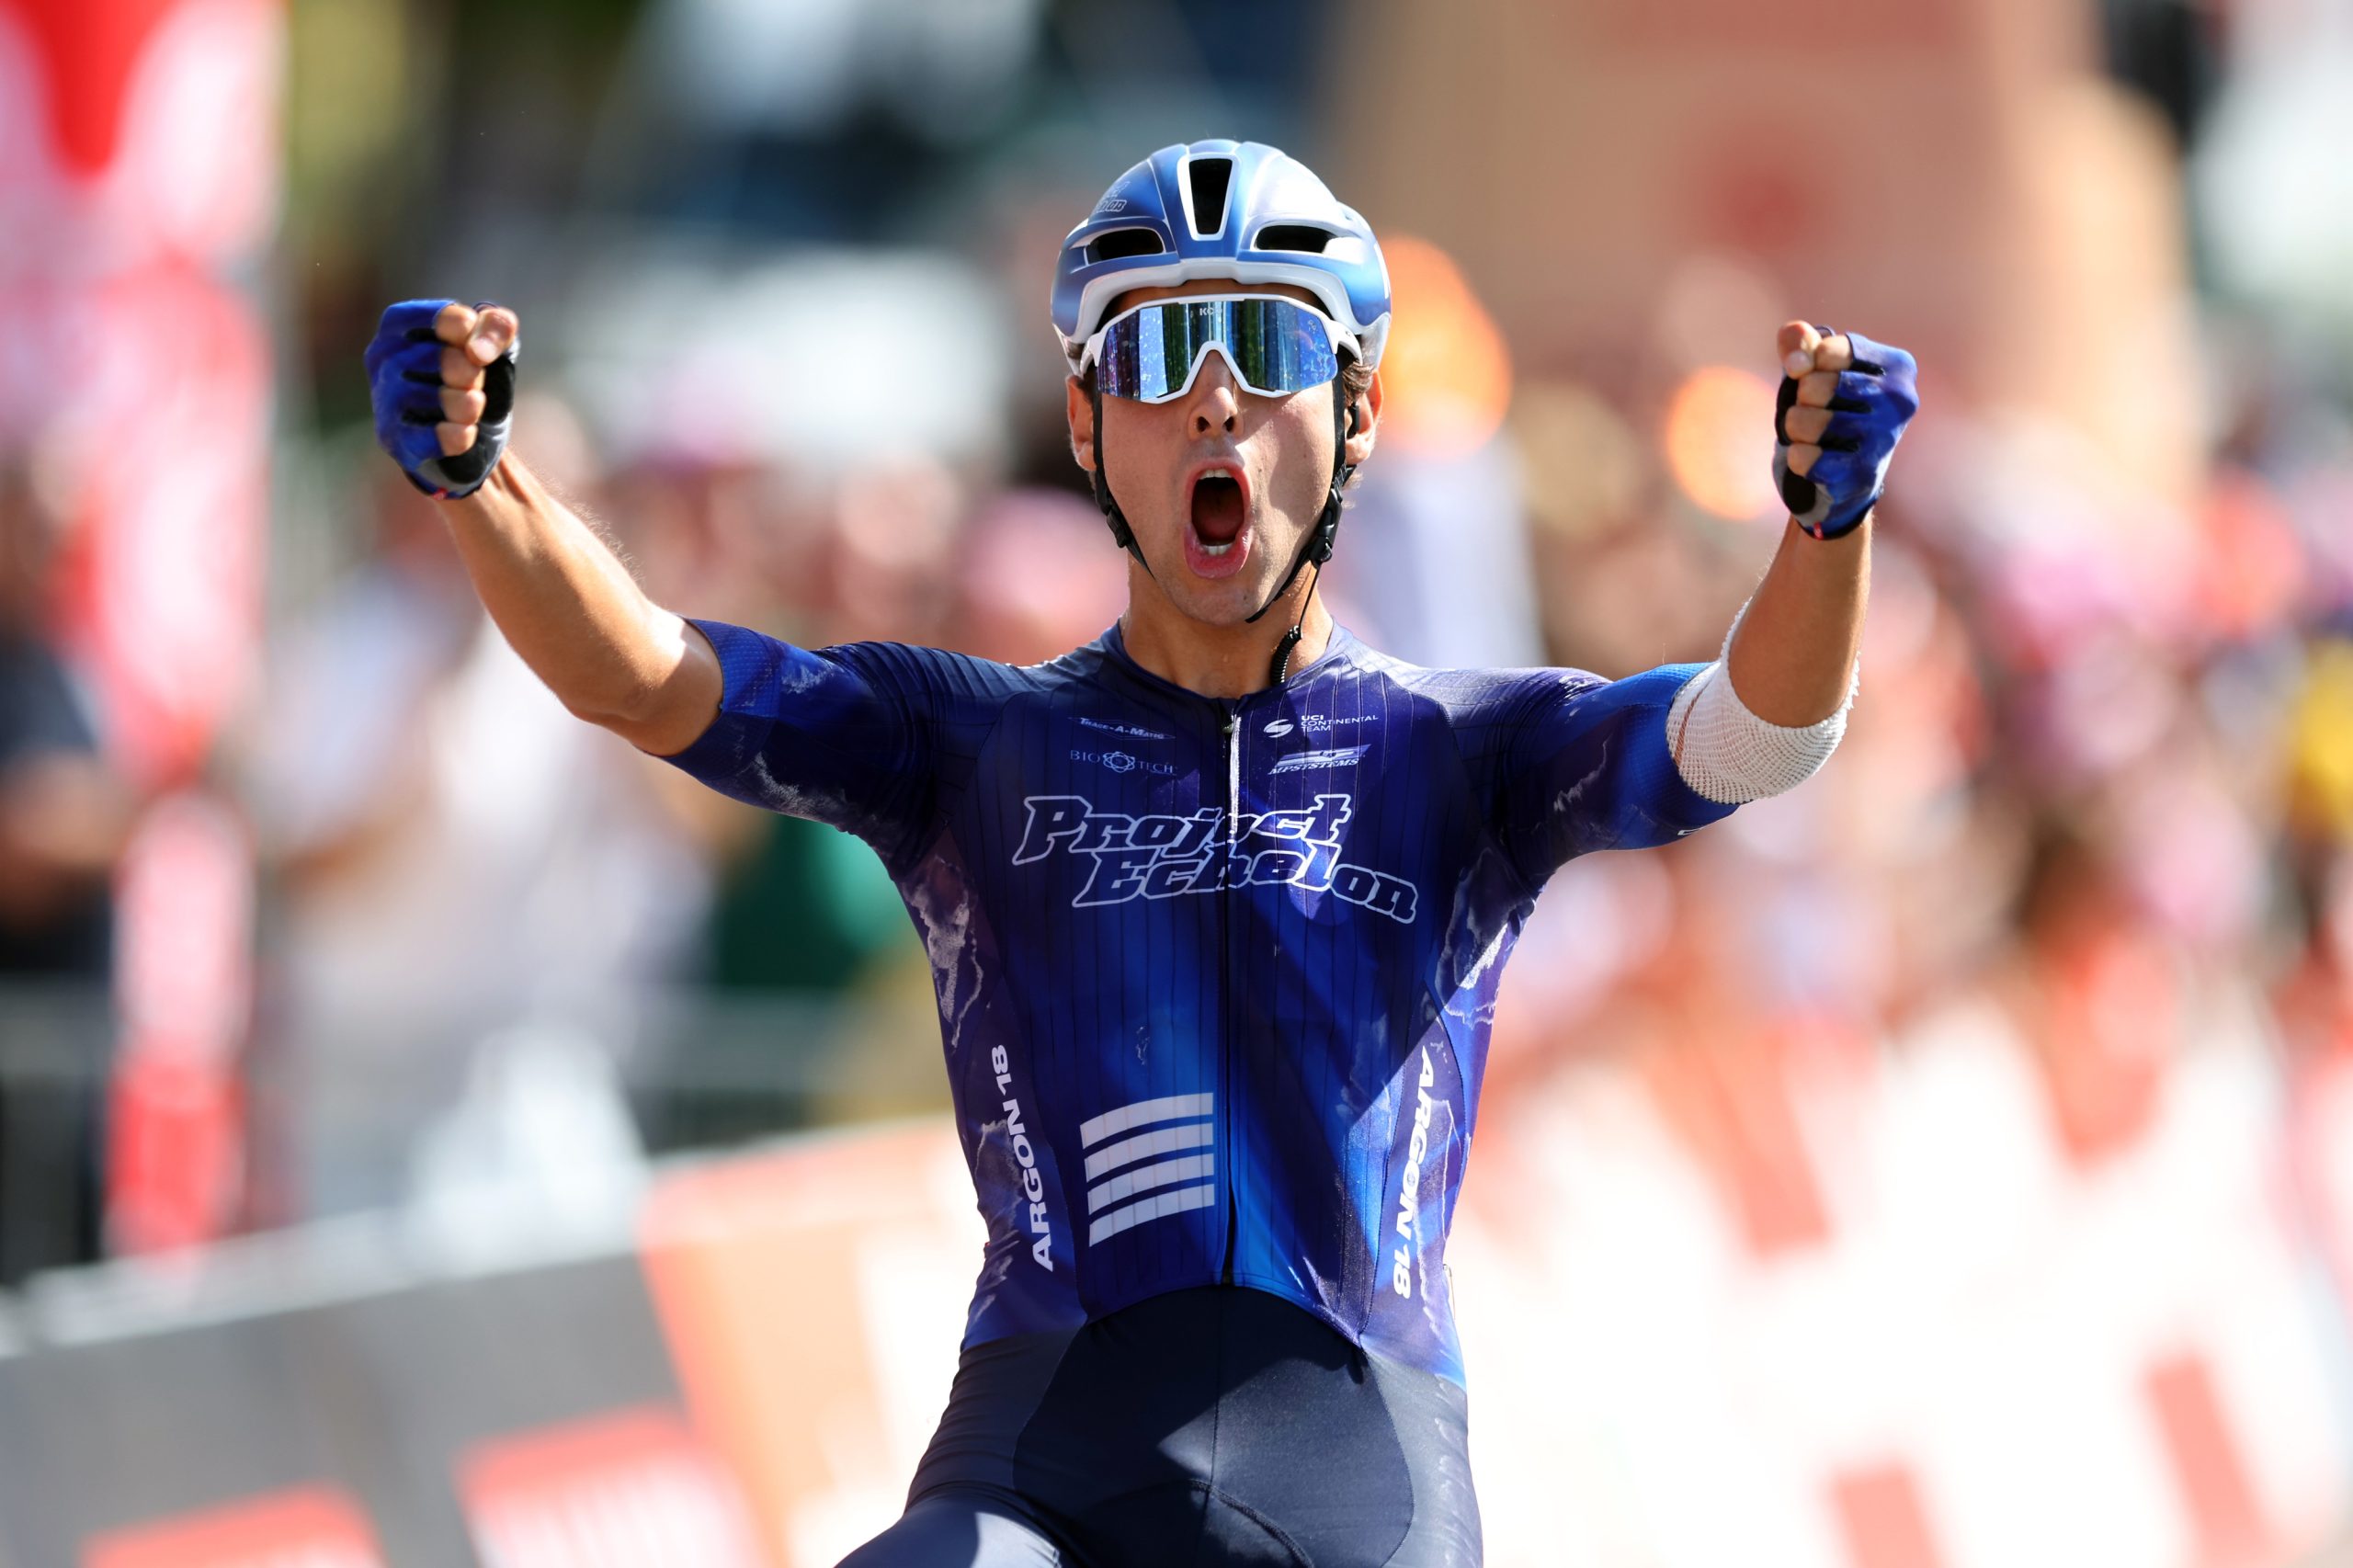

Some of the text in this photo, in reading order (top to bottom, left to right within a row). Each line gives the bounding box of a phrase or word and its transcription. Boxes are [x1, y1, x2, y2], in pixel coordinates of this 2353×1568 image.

[1301, 714, 1379, 727] CONTINENTAL
[1302, 724, 1332, 733] TEAM
[1072, 840, 1418, 925] Echelon
[991, 1044, 1054, 1272] ARGON 18
[1392, 1045, 1434, 1300] ARGON 18
